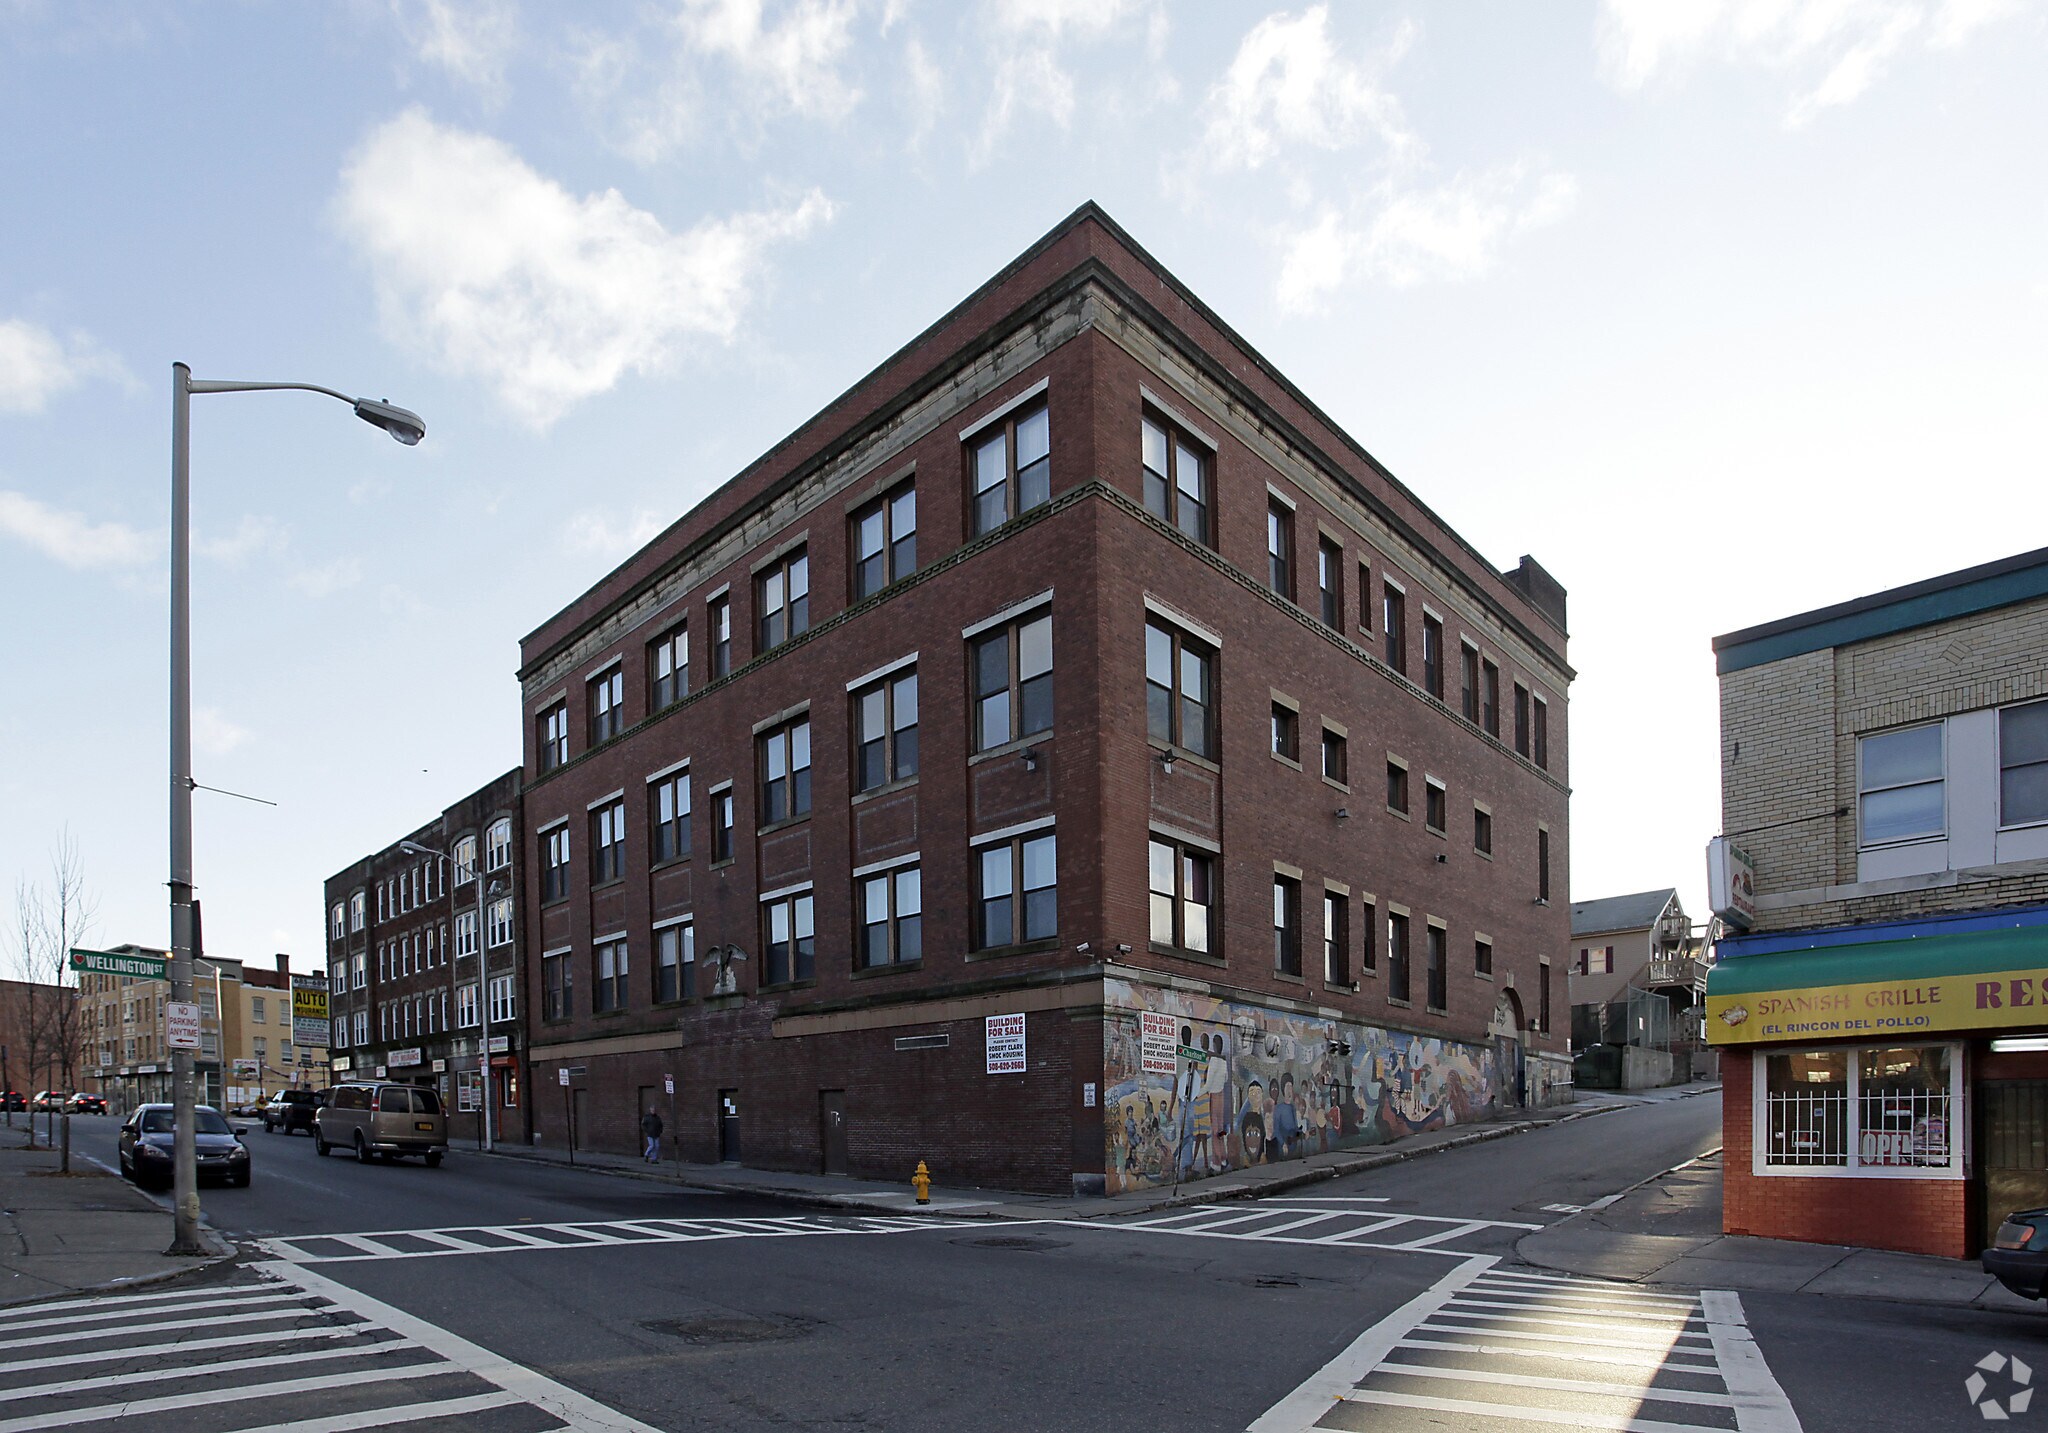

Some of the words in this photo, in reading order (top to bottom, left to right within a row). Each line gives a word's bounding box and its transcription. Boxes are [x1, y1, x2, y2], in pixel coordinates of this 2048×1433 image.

[85, 955, 155, 976] WELLINGTON
[154, 964, 164, 974] ST
[295, 991, 327, 1007] AUTO
[1758, 994, 1849, 1016] SPANISH
[1864, 986, 1942, 1008] GRILLE
[178, 1007, 189, 1016] NO
[169, 1017, 198, 1028] PARKING
[988, 1016, 1023, 1028] BUILDING
[1143, 1014, 1175, 1027] BUILDING
[1761, 1024, 1783, 1036] (EL
[1786, 1021, 1840, 1033] RINCON
[1844, 1019, 1871, 1030] DEL
[1876, 1015, 1931, 1028] POLLO)
[169, 1028, 199, 1038] ANYTIME
[988, 1028, 1003, 1037] FOR
[1004, 1026, 1024, 1035] SALE
[1143, 1024, 1157, 1033] FOR
[1159, 1026, 1175, 1036] SALE
[1008, 1043, 1023, 1051] CLARK
[1143, 1042, 1160, 1050] ROBERT
[1156, 1051, 1175, 1059] HOUSING
[988, 1061, 1024, 1071] 508-620-2668
